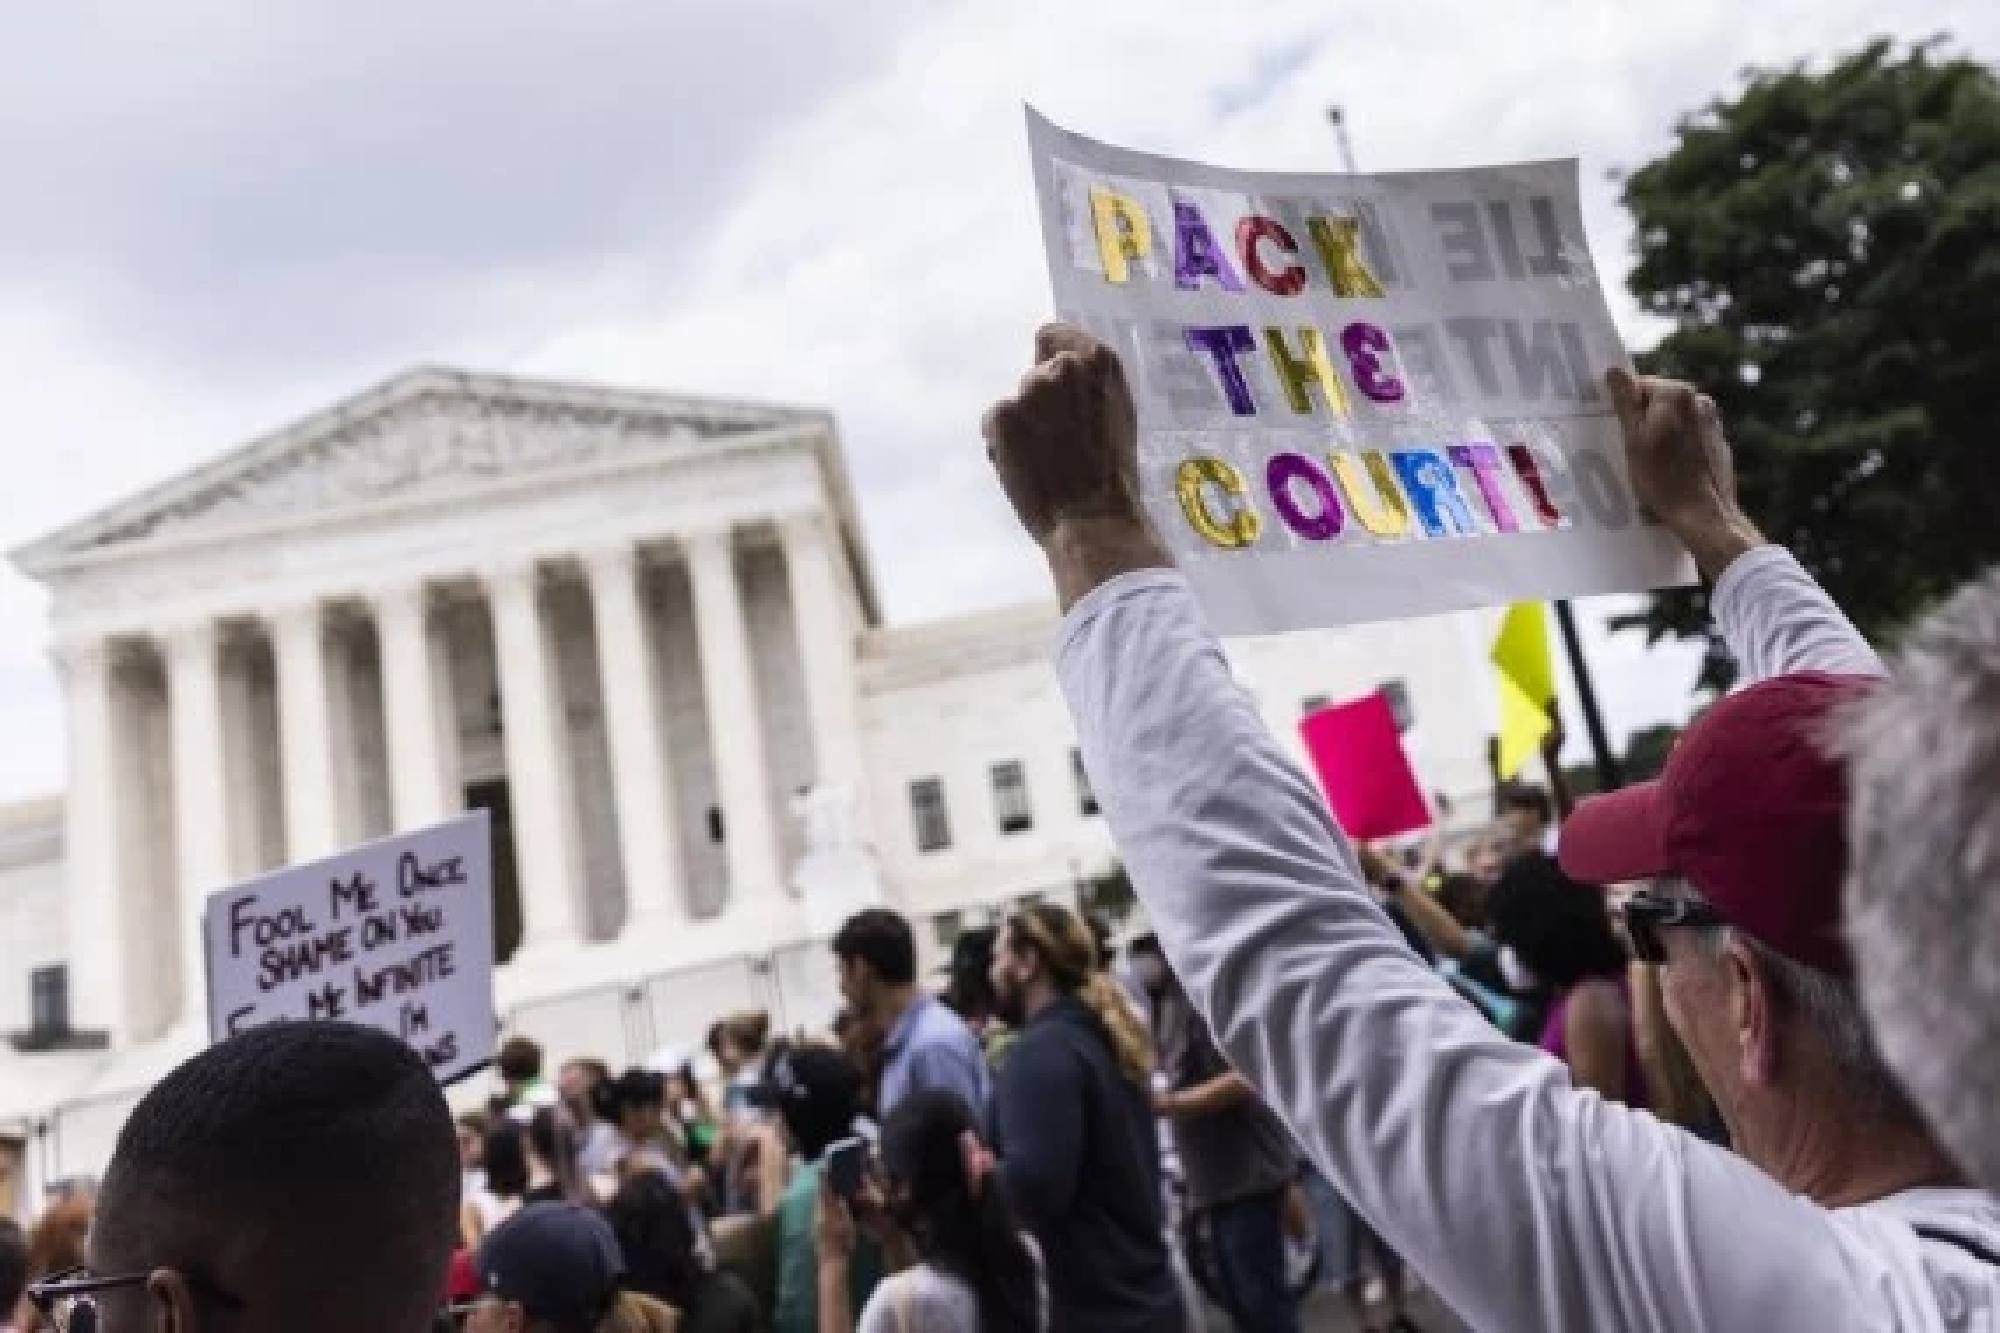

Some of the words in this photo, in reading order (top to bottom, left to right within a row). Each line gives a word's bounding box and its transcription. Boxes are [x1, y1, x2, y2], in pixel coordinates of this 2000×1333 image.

[1089, 185, 1386, 299] PACK
[1186, 322, 1404, 418] THE
[256, 925, 354, 992] SHAME
[361, 907, 397, 951] ON
